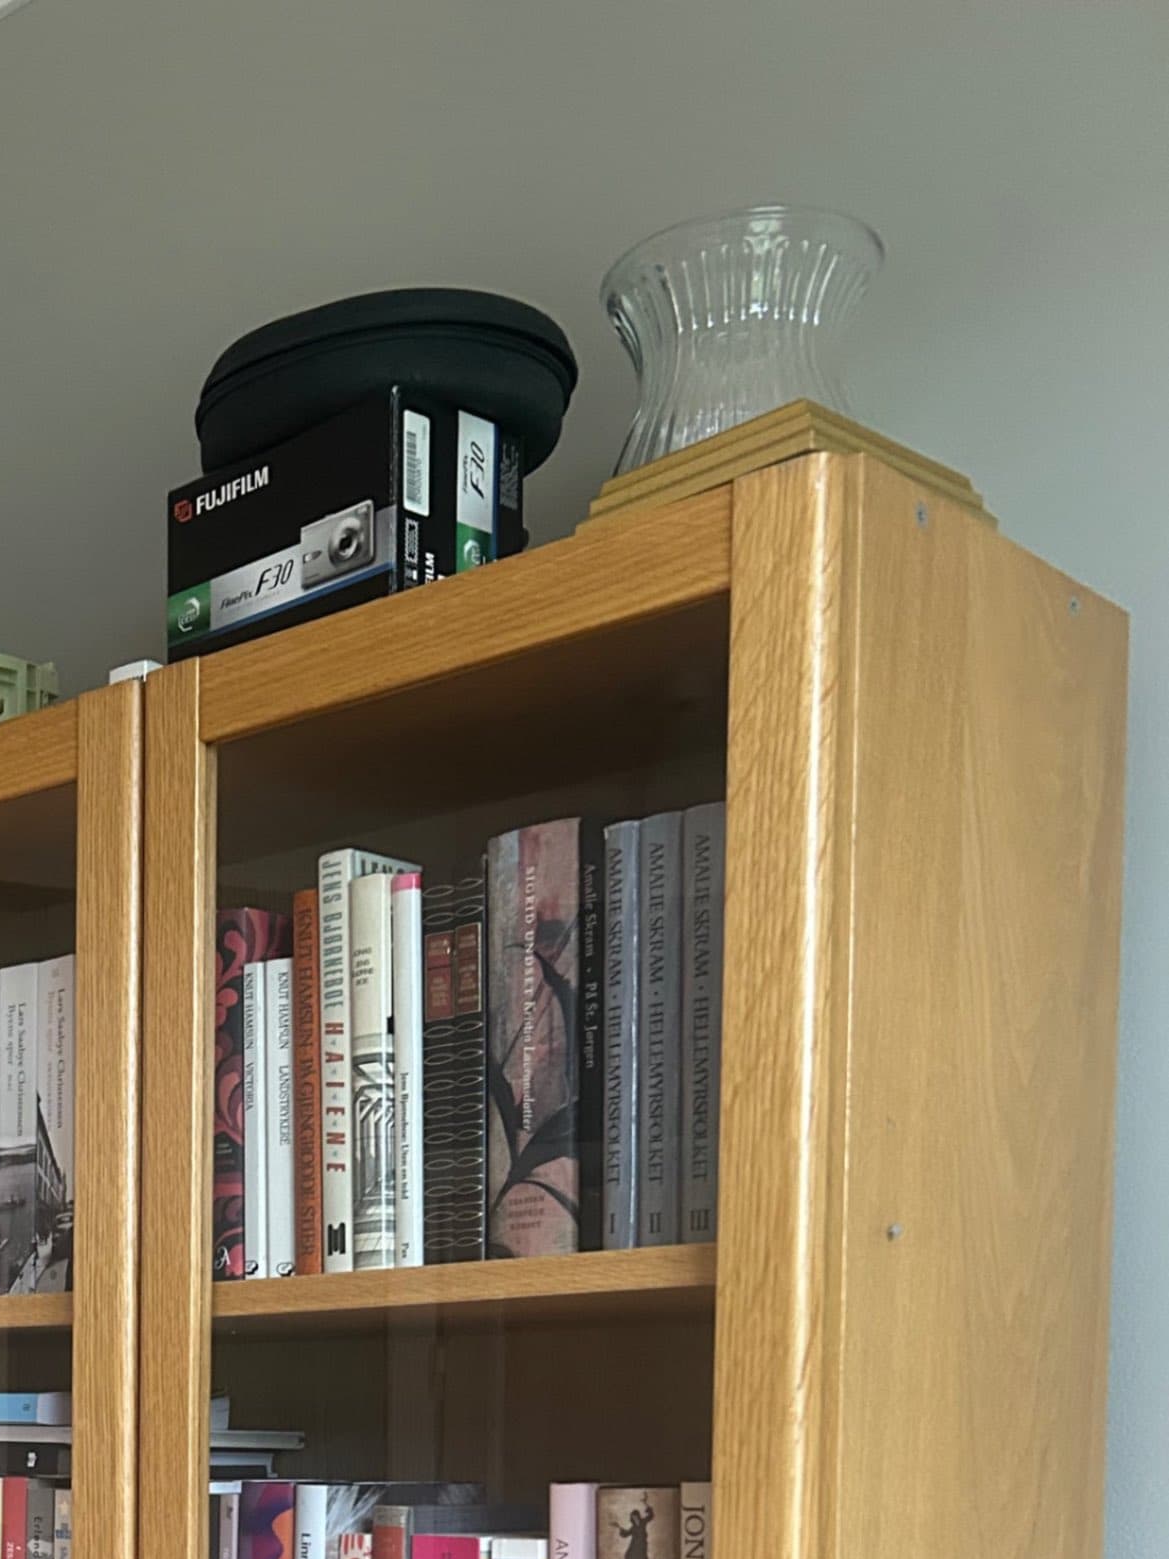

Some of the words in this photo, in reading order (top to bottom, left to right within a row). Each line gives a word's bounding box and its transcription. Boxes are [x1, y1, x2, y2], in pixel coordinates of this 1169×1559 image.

[195, 466, 270, 515] FUJIFILM
[469, 441, 485, 499] F30
[254, 560, 294, 597] F30
[322, 860, 341, 905] JENS
[584, 864, 597, 909] Amalie
[608, 847, 623, 915] AMALIE
[648, 842, 664, 914] AMALIE
[693, 835, 710, 906] AMALIE
[523, 866, 535, 925] SIGRID
[297, 908, 313, 960] KNUT
[584, 912, 597, 957] Skram
[608, 918, 623, 986] SKRAM
[648, 916, 664, 984] SKRAM
[693, 909, 710, 977] SKRAM
[278, 972, 289, 1000] KNUT
[323, 914, 343, 1010] BJØRNEBOE
[523, 931, 535, 996] UNDSET
[56, 988, 66, 1013] Lars
[244, 972, 253, 1001] KNUT
[297, 967, 313, 1047] HAMSUN
[584, 982, 597, 1000] På
[16, 1003, 27, 1027] Lars
[54, 1016, 67, 1055] Saabye
[244, 1003, 253, 1050] HAMSUN
[278, 1003, 289, 1050] HAMSUN
[523, 1001, 535, 1042] Kristin
[15, 1030, 27, 1067] Saabye
[584, 1024, 597, 1068] Jørgen
[16, 1070, 27, 1137] Christensen
[56, 1060, 67, 1129] Christensen
[244, 1062, 253, 1110] VICTORIA
[400, 1072, 409, 1090] Jens
[606, 1005, 622, 1186] HELLEMYRSFOLKET
[647, 1002, 663, 1186] HELLEMYRSFOLKET
[691, 998, 709, 1182] HELLEMYRSFOLKET
[279, 1065, 290, 1146] LANDSTRYKERE
[649, 1211, 661, 1234] II
[690, 1208, 710, 1232] III
